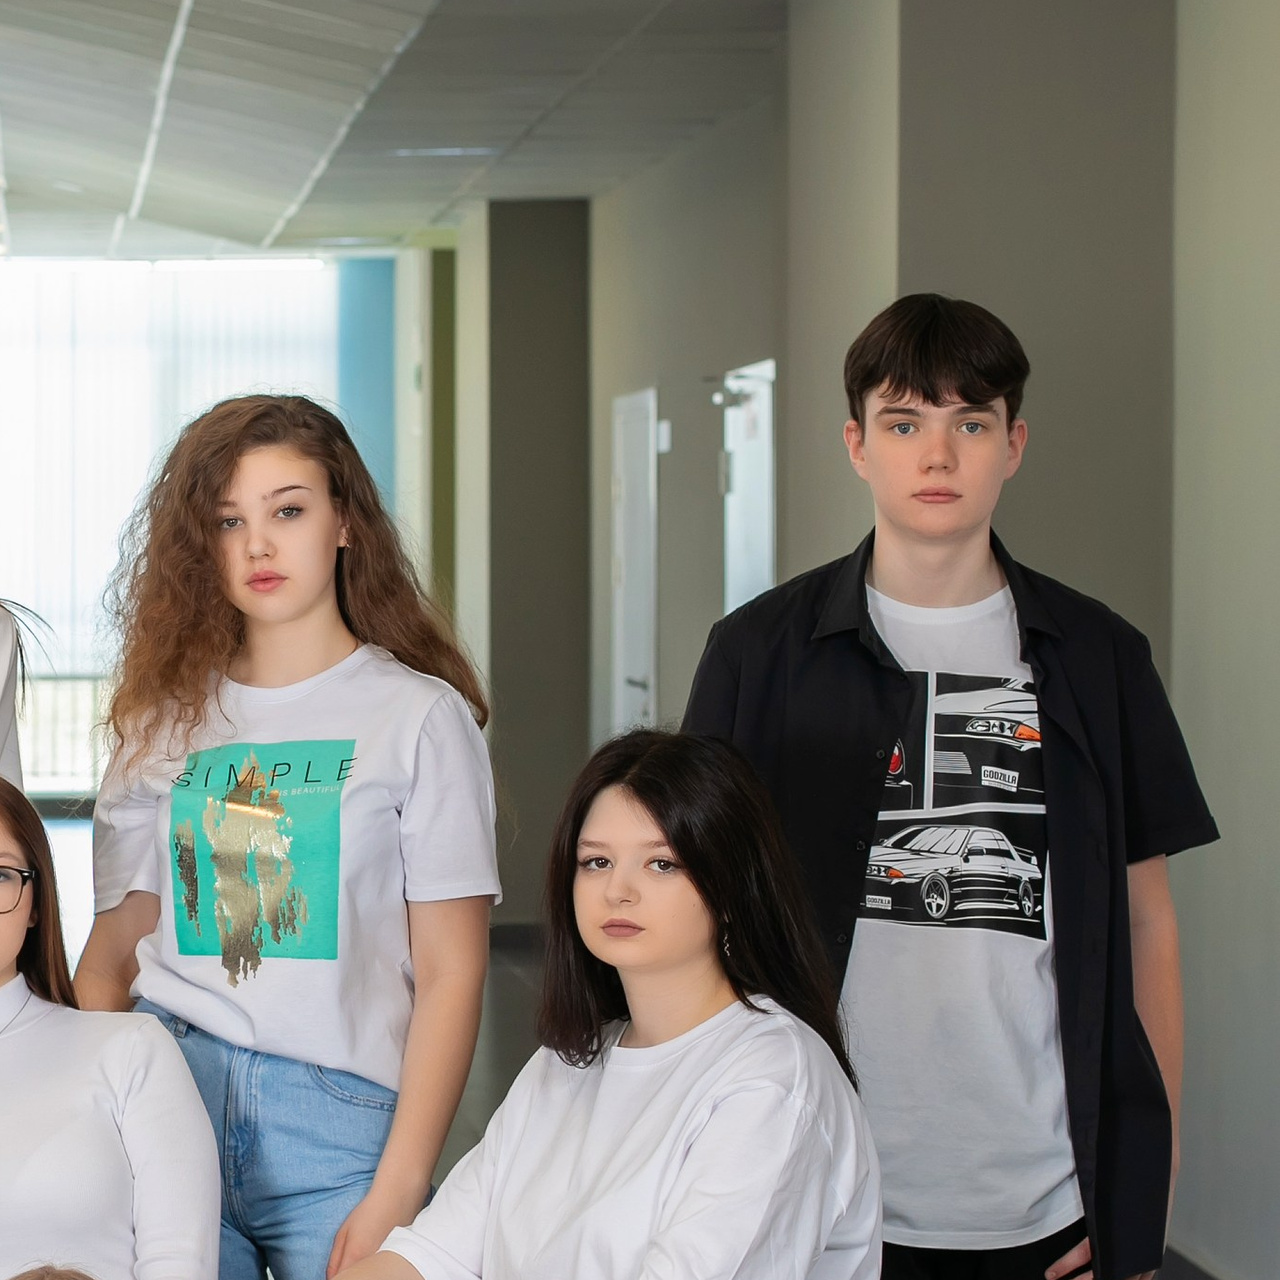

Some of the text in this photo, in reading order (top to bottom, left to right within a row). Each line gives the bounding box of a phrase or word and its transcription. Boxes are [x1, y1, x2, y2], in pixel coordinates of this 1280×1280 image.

[171, 757, 358, 788] SIMPLE
[983, 769, 1017, 785] GODZILLA
[278, 784, 340, 797] IS BEAUTIFUL
